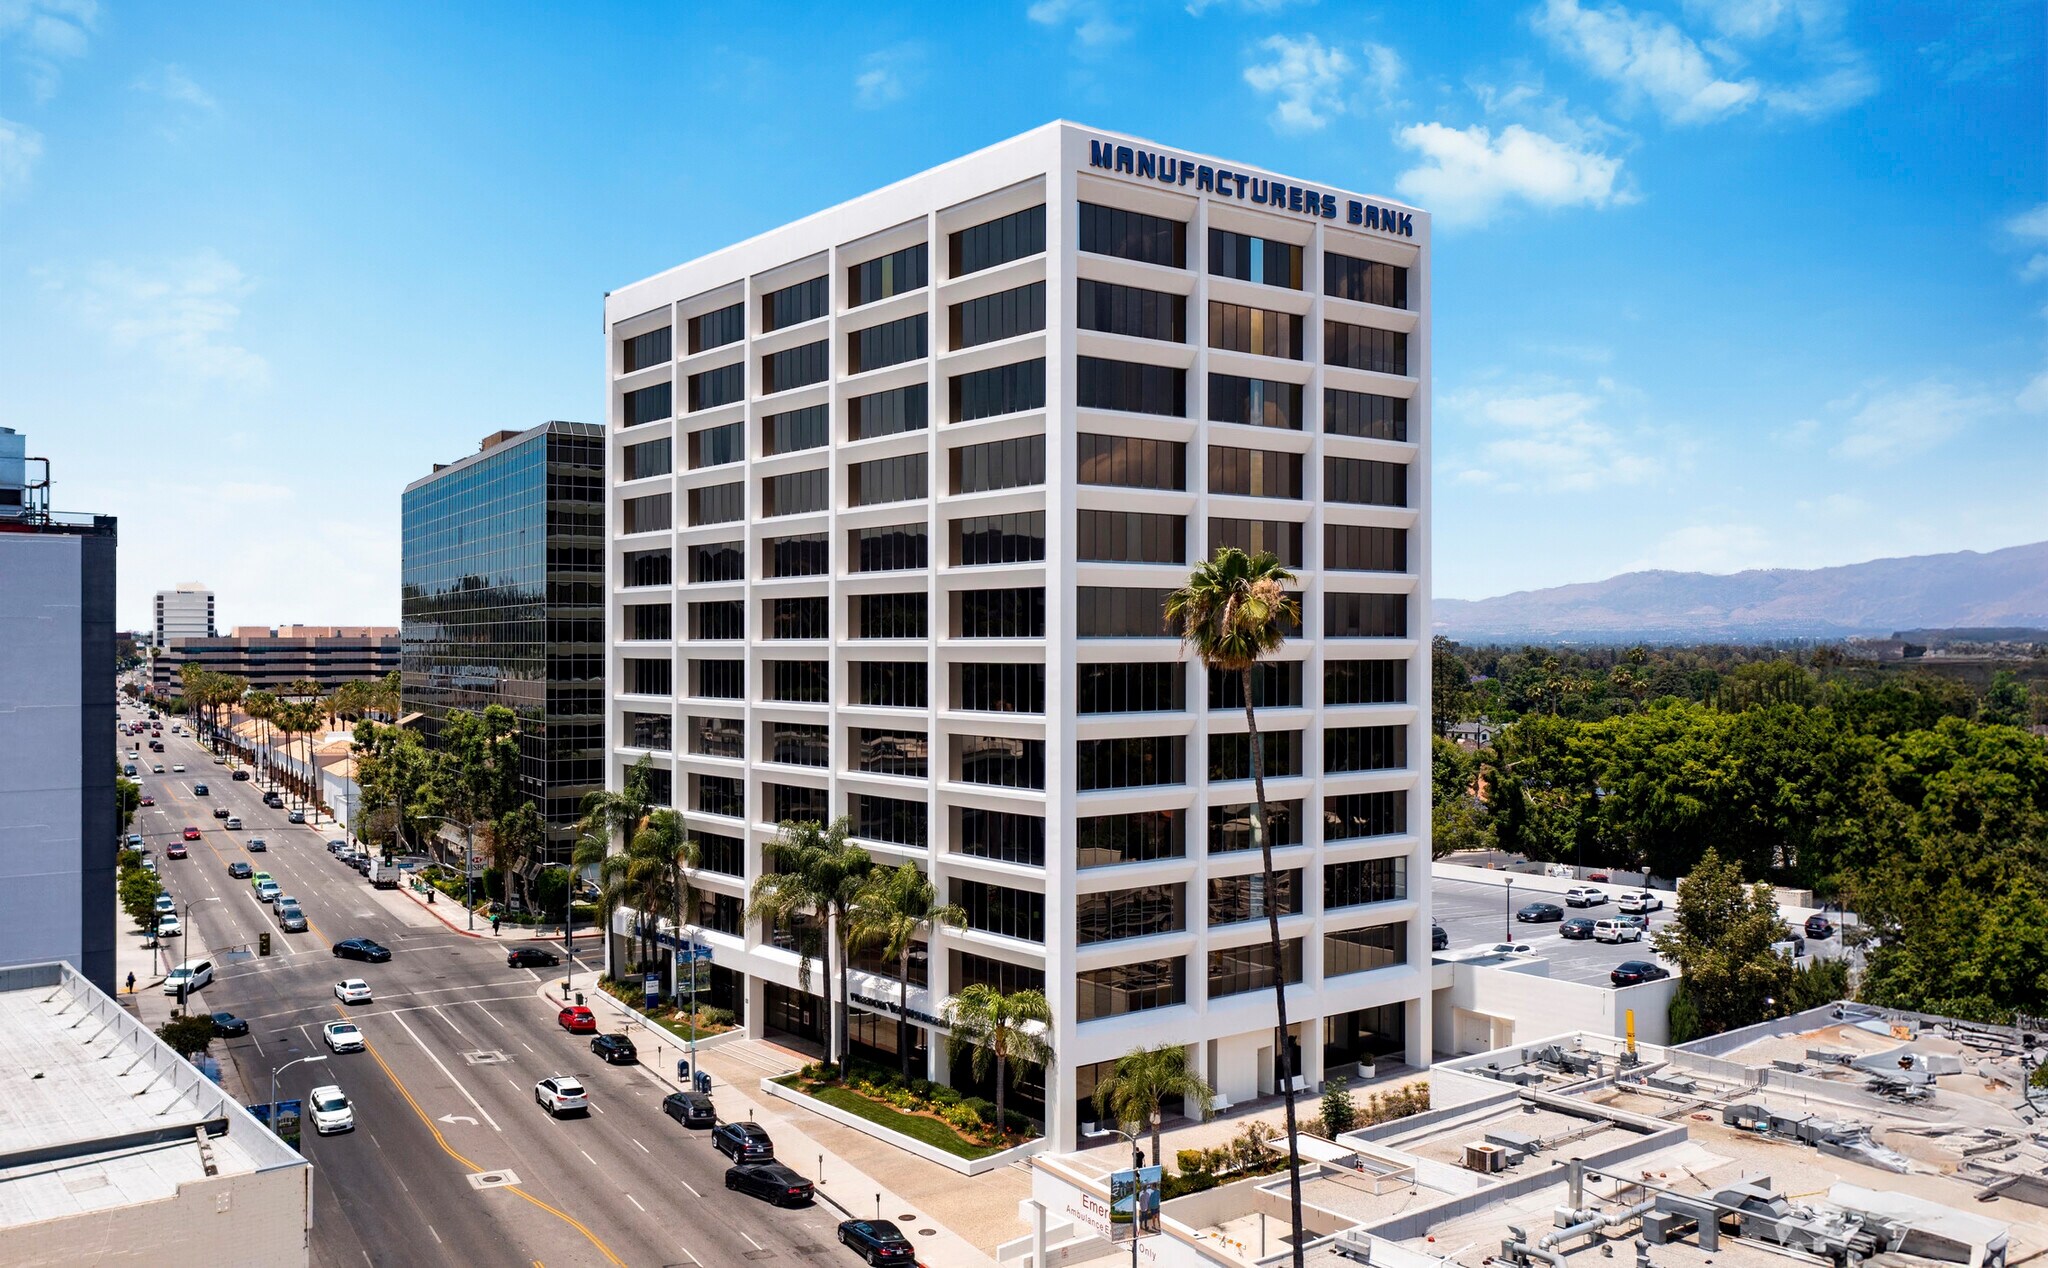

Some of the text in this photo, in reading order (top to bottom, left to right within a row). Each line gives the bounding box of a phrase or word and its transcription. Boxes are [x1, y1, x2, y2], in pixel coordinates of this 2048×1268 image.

[1089, 139, 1413, 237] MANUFACTURERS BANK
[1066, 1204, 1104, 1231] Ambulance
[1139, 1243, 1156, 1261] Only
[1083, 1194, 1111, 1220] Emer
